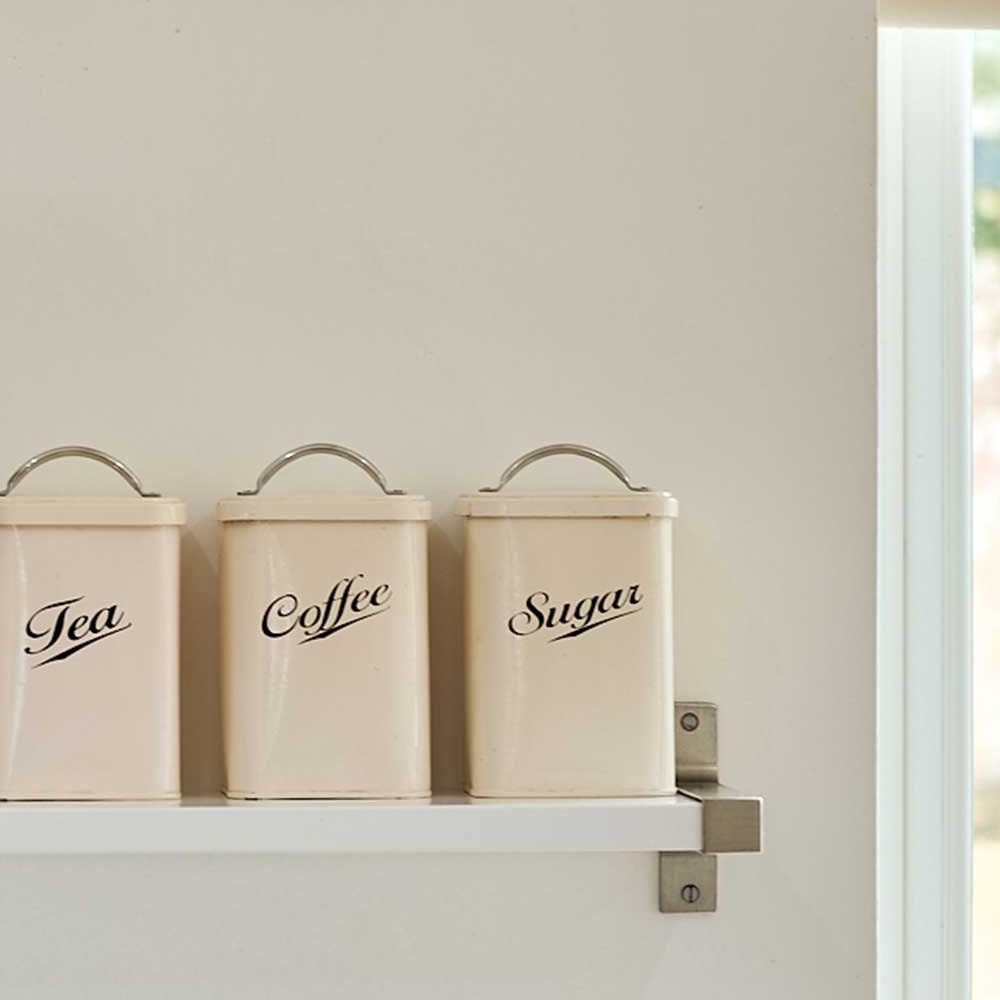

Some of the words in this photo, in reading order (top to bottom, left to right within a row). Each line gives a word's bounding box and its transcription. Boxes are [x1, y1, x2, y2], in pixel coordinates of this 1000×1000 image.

[24, 596, 131, 666] Tea
[261, 574, 391, 644] Coffee
[508, 582, 643, 642] Sugar
